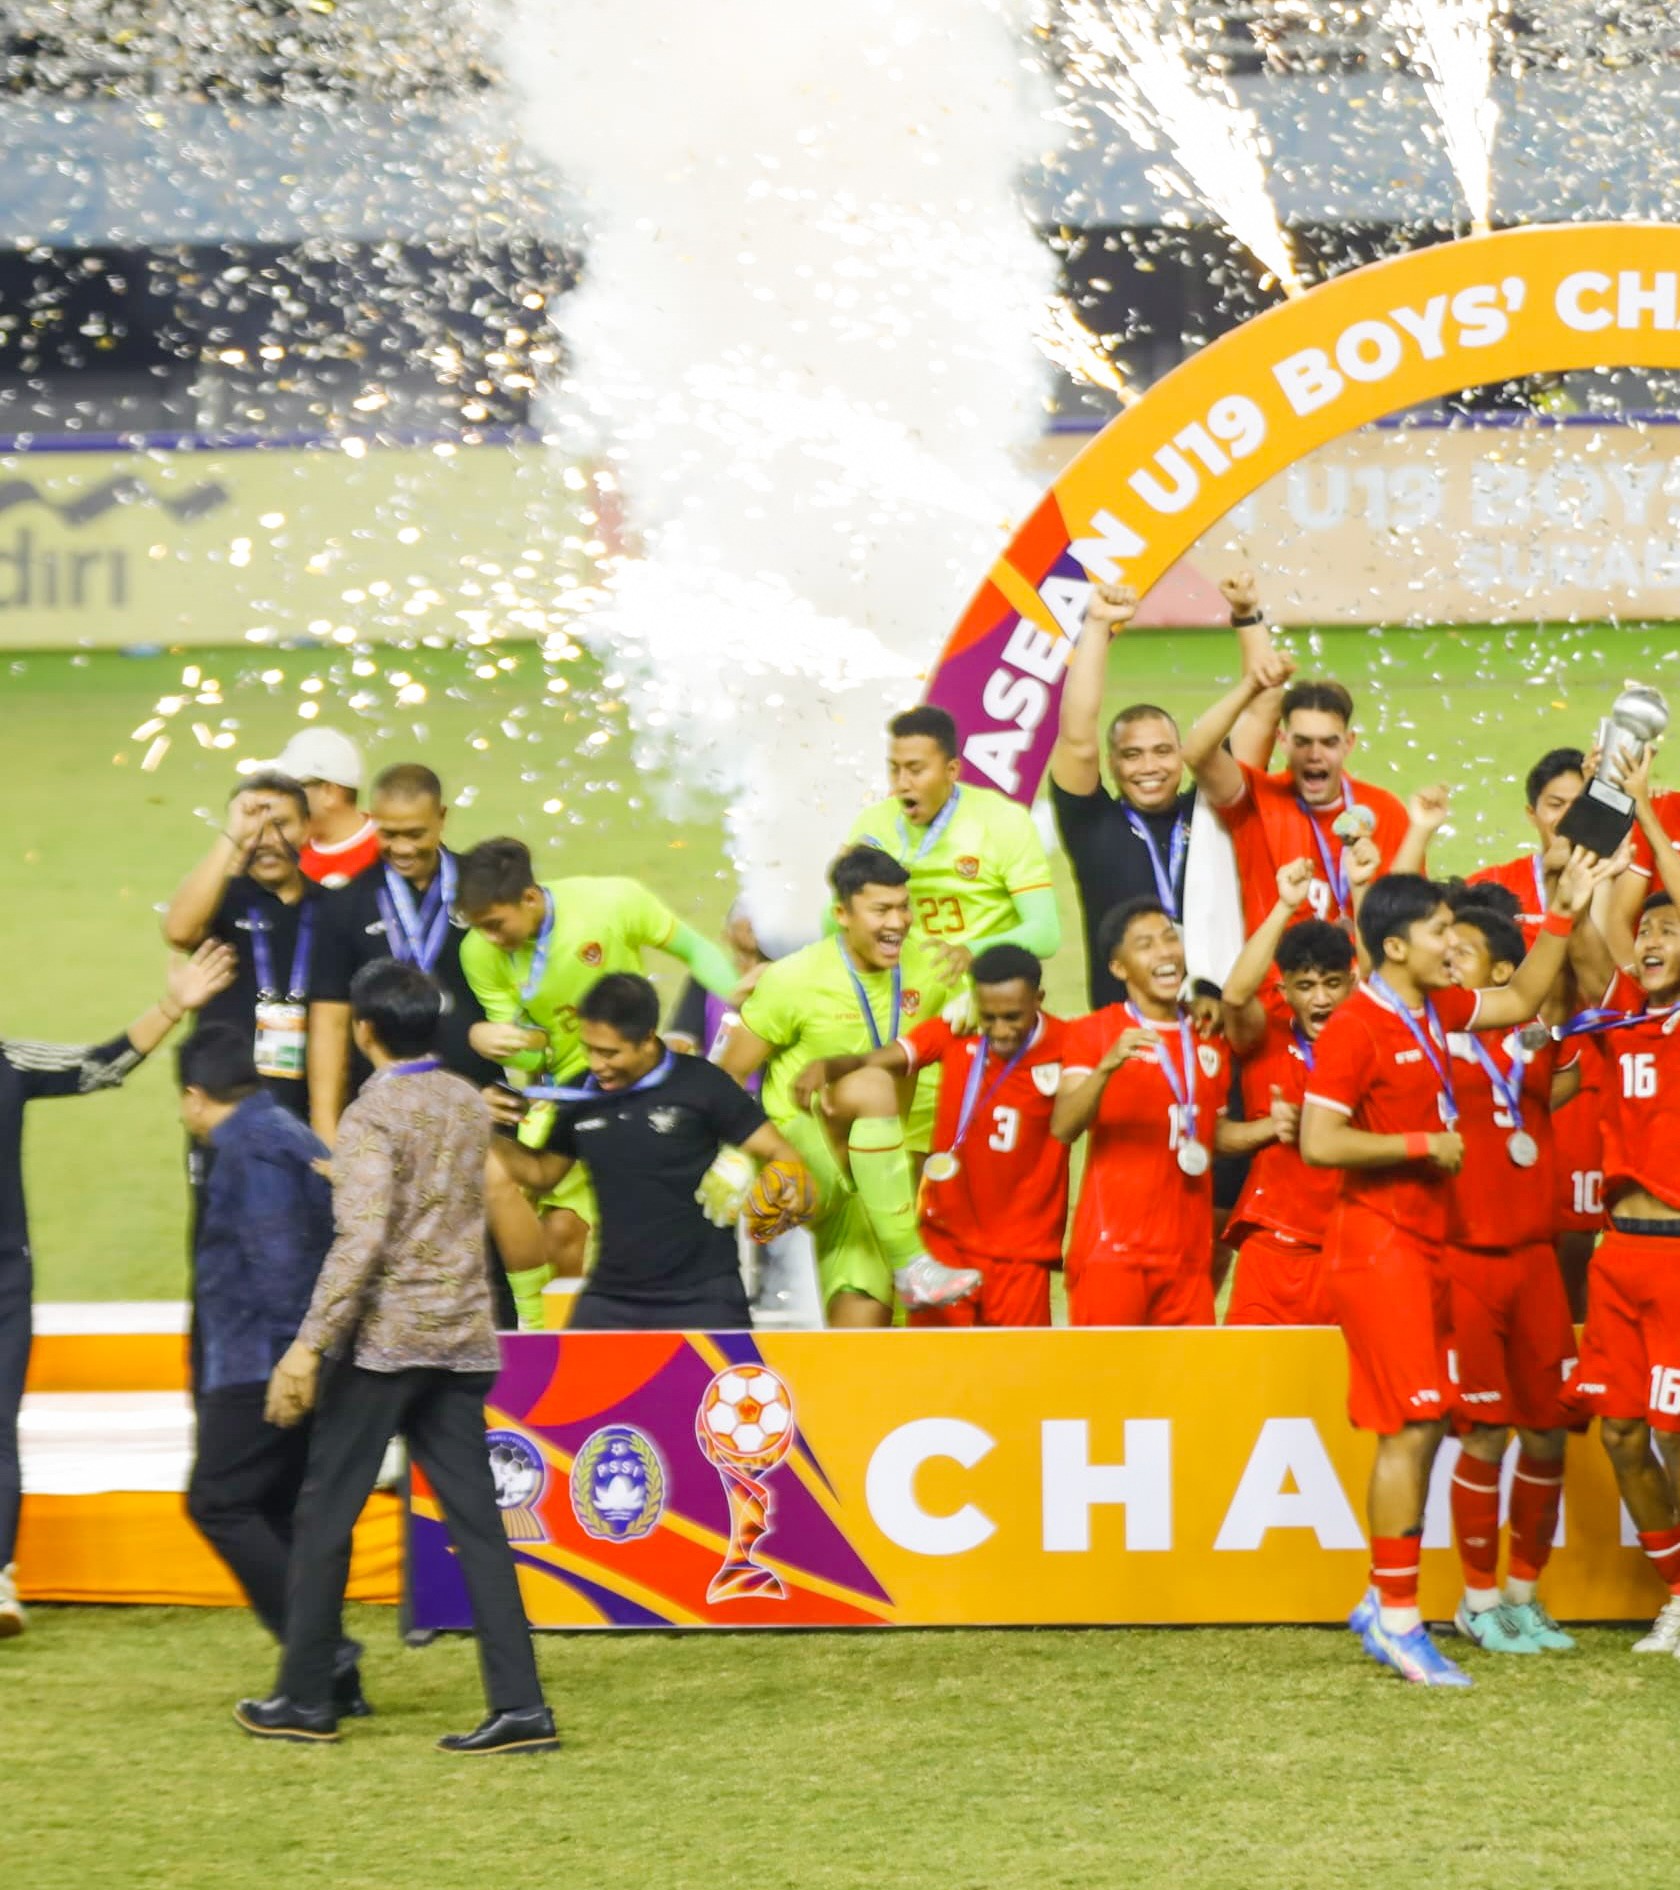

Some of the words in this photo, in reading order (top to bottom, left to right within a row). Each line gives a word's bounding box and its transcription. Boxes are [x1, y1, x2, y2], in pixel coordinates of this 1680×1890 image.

[962, 508, 1148, 795] ASEAN
[1128, 395, 1267, 514] U19
[1272, 277, 1527, 415] BOYS'
[917, 896, 965, 934] 23
[1619, 1053, 1657, 1099] 16
[988, 1106, 1020, 1152] 3
[597, 1460, 639, 1479] PSSI
